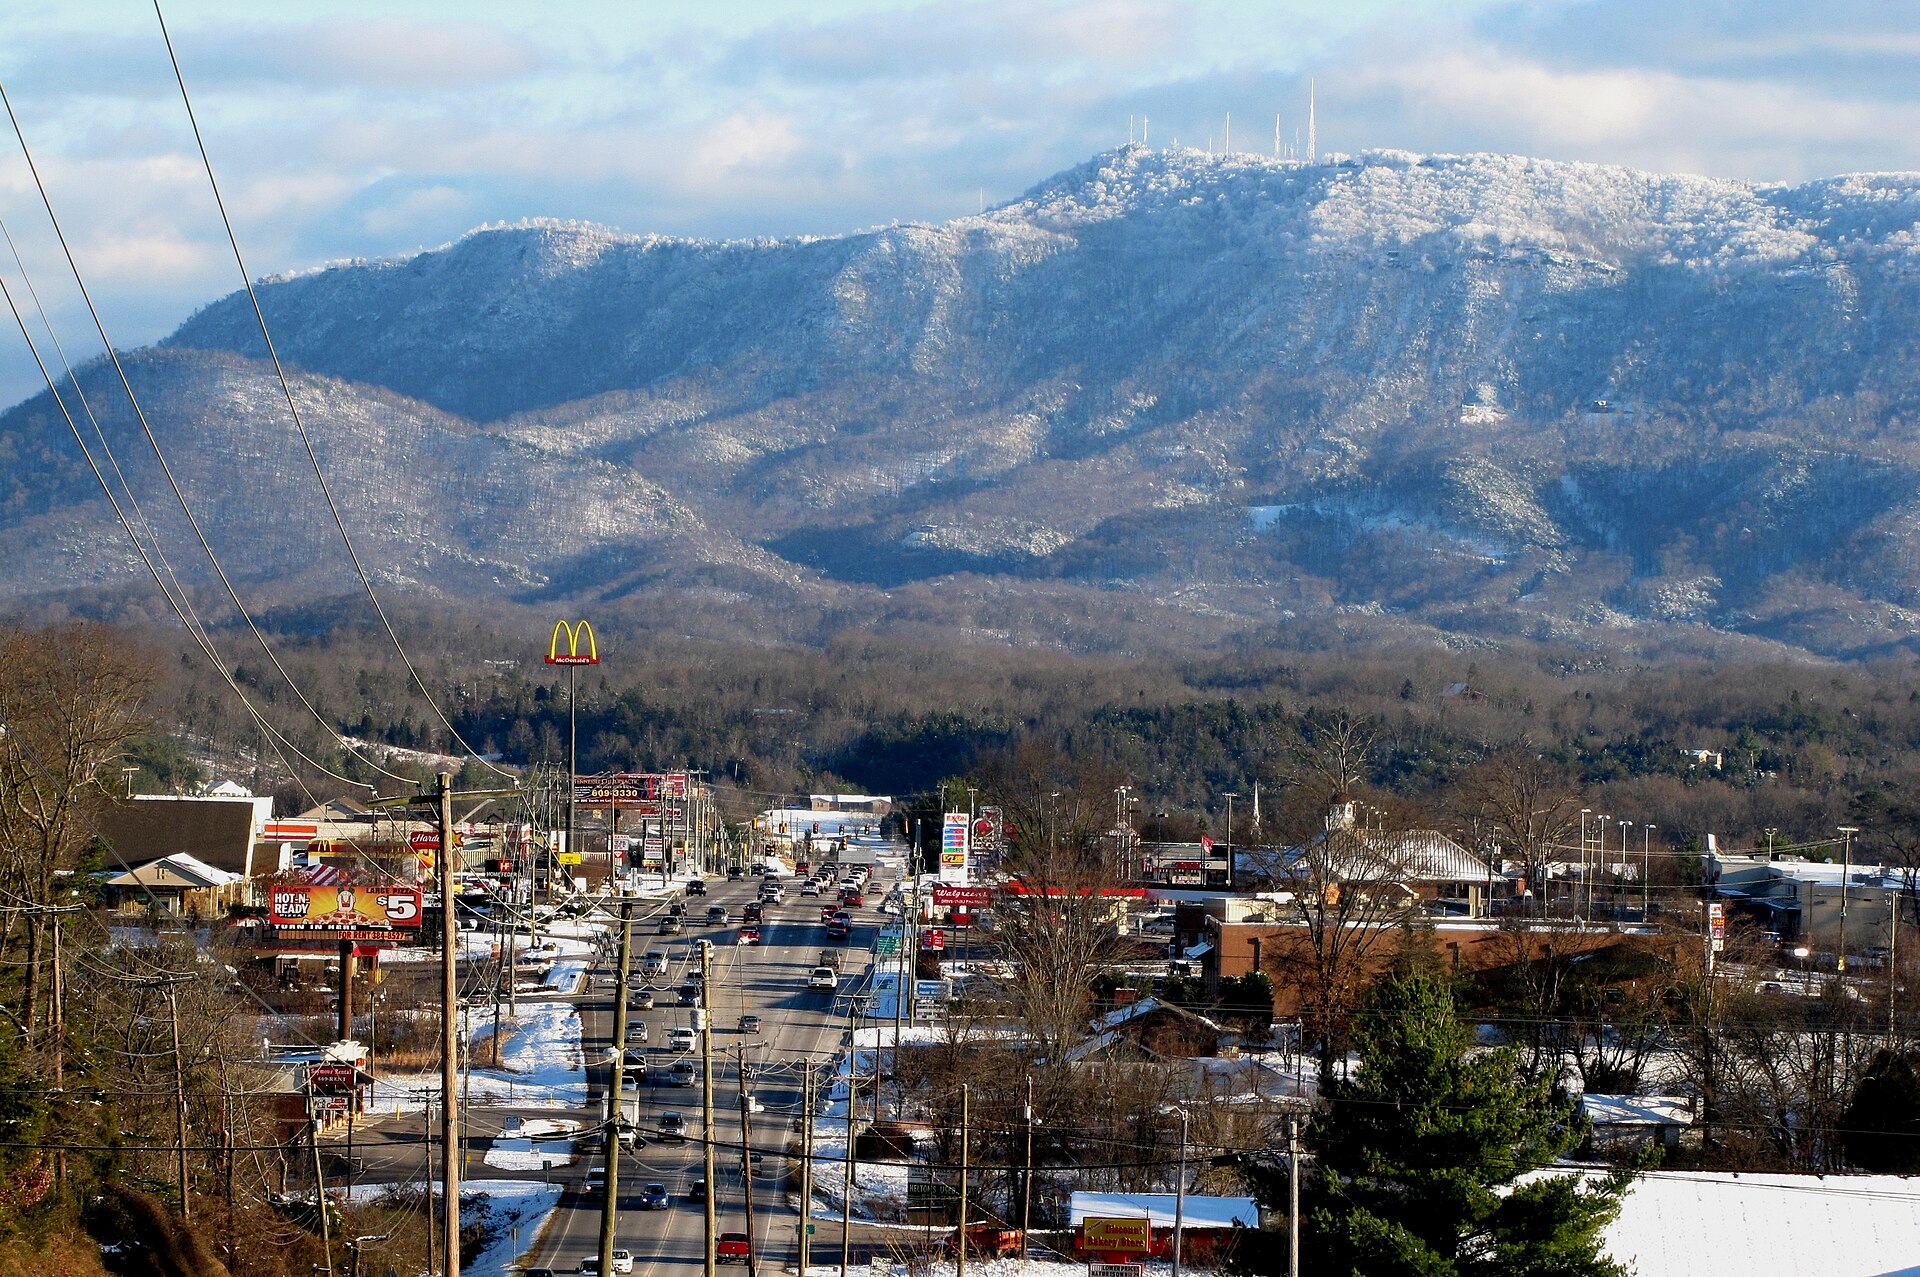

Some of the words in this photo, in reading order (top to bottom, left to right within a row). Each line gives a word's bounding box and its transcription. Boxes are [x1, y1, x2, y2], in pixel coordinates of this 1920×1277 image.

[591, 789, 638, 798] 609-3330
[946, 815, 967, 824] EXXON
[275, 893, 310, 904] HOT-N-
[936, 889, 988, 899] Walgreens
[275, 904, 309, 914] READY
[376, 895, 418, 919] $5
[338, 931, 352, 939] FOR
[354, 931, 371, 939] RENT
[372, 931, 405, 940] 384-8527
[1105, 1224, 1145, 1235] Discount
[1087, 1236, 1119, 1248] Bakery
[1120, 1237, 1146, 1248] Store
